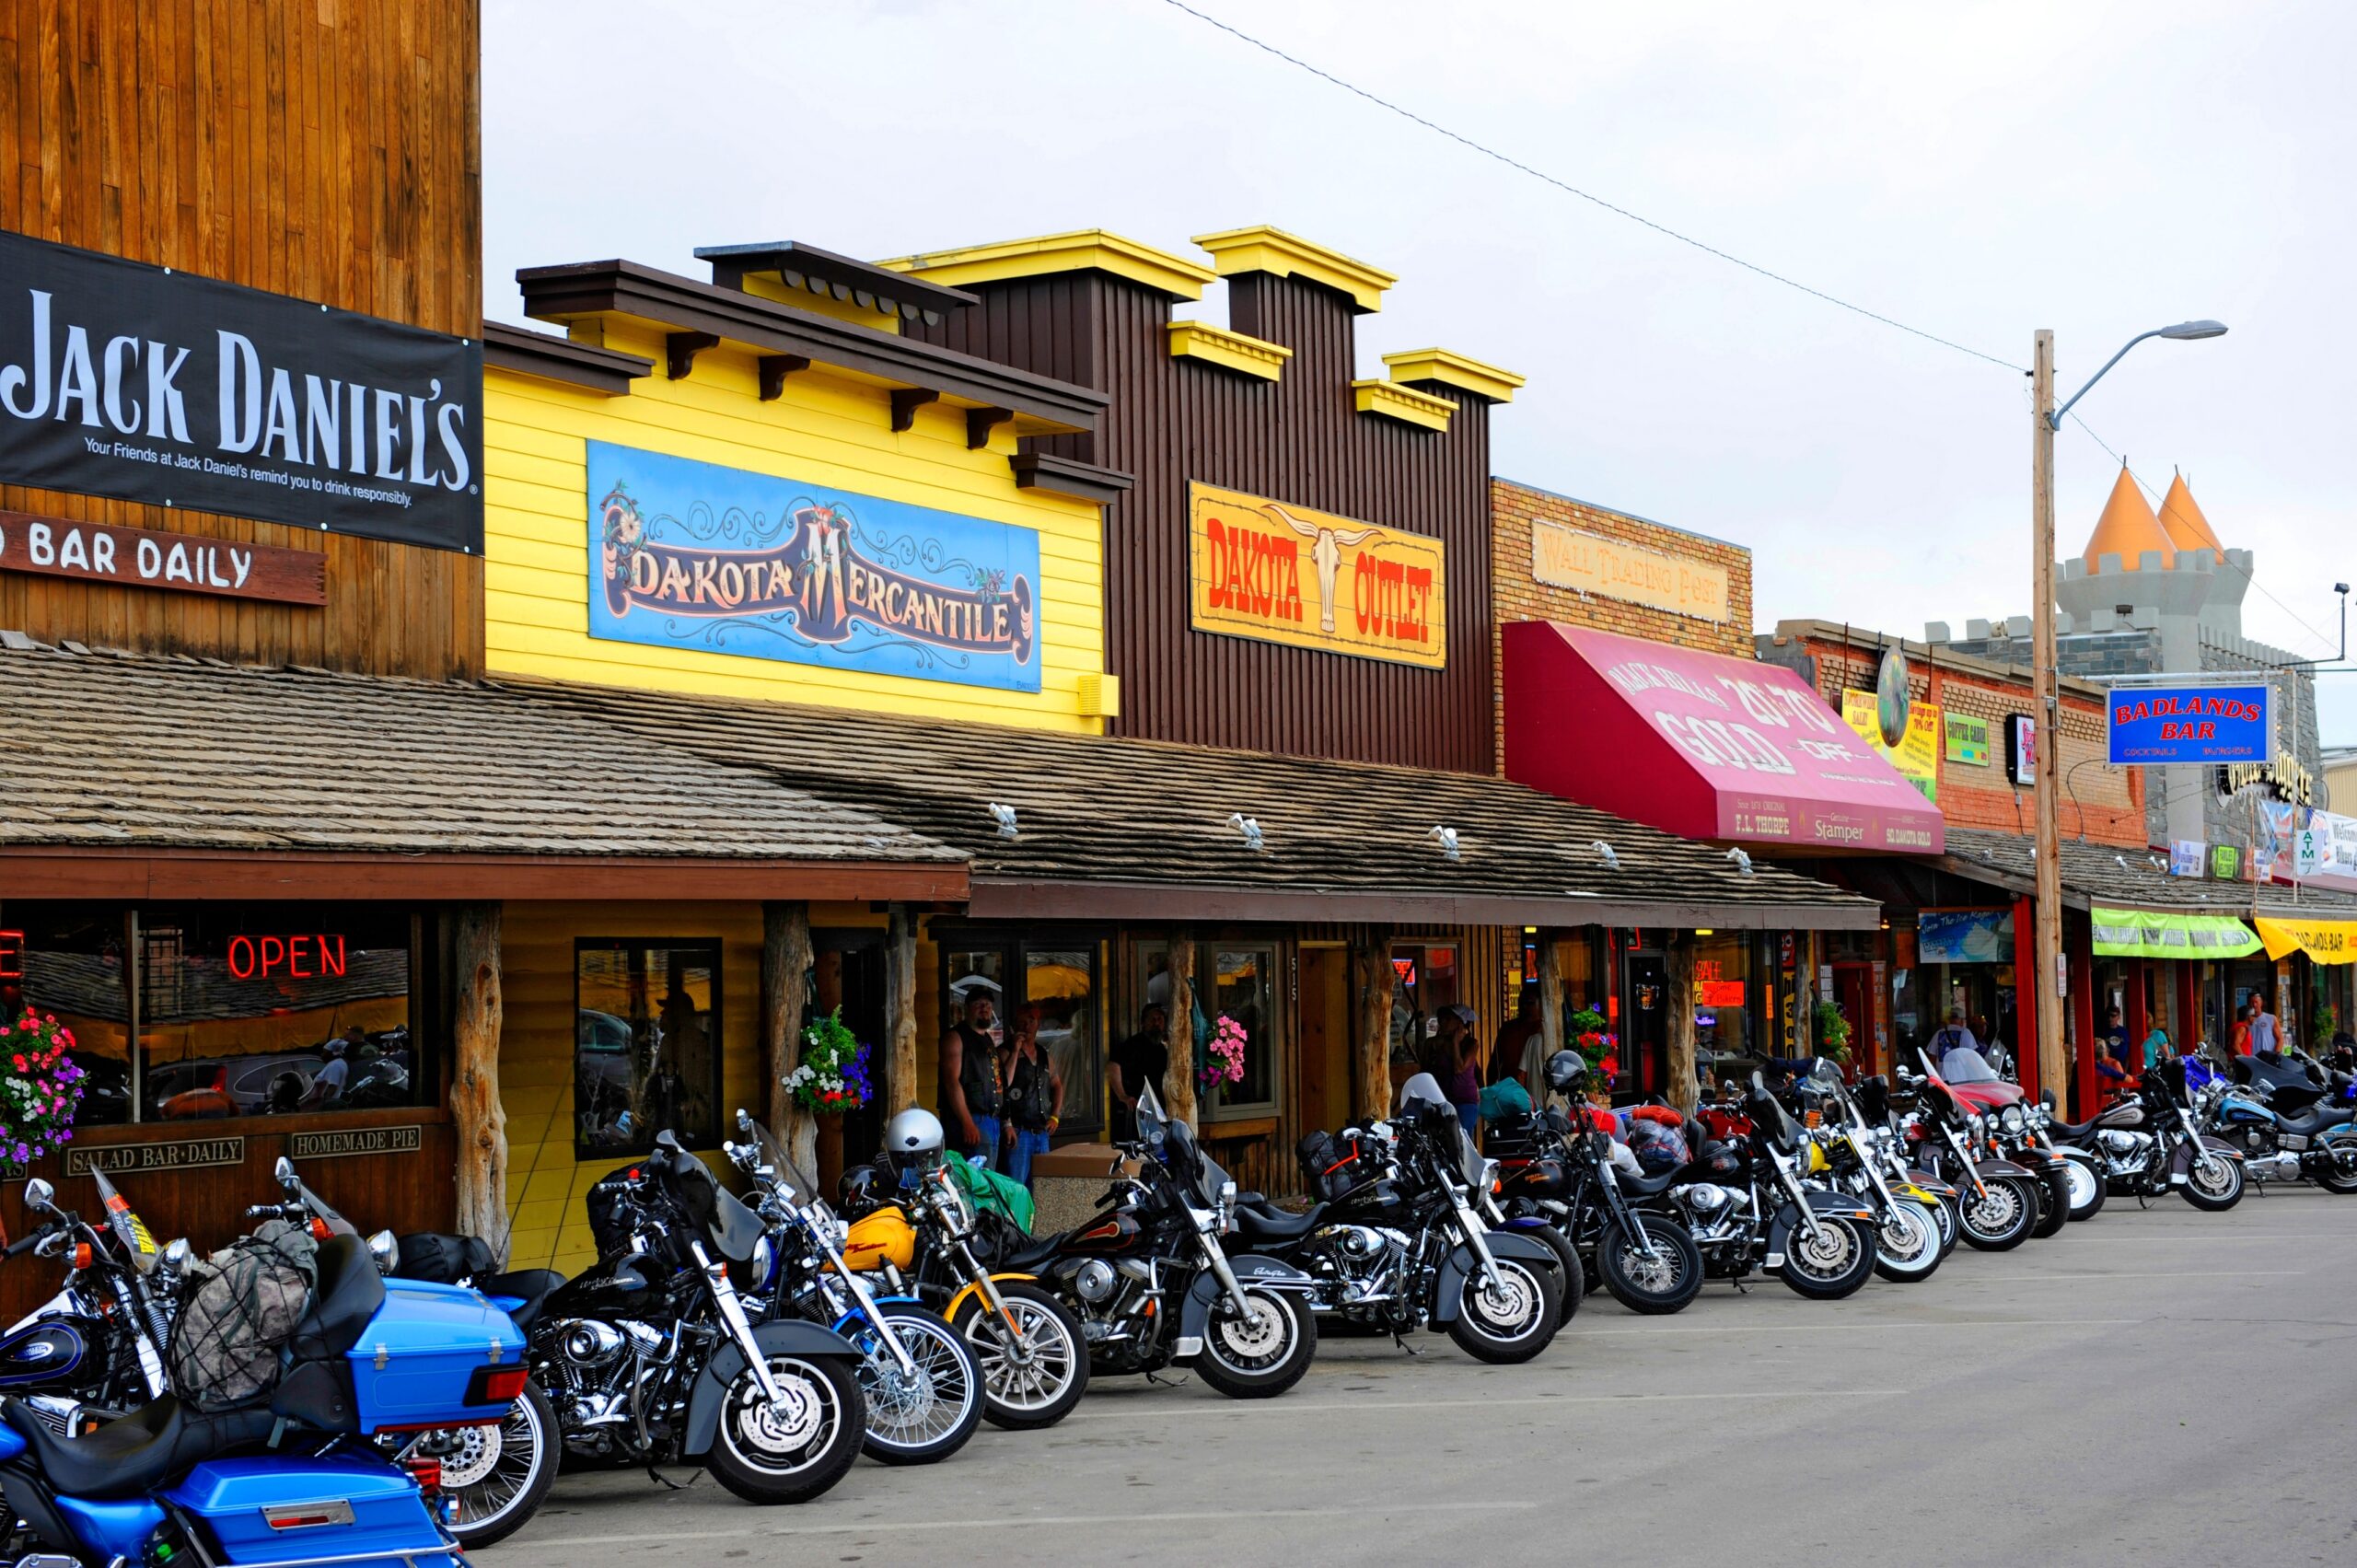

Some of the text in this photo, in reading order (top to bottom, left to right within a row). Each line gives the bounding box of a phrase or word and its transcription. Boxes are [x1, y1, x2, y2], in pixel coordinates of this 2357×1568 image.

[0, 289, 470, 492] JACK DANIEL'S
[85, 437, 412, 508] Your Friends at Jack Daniel's remind you to drink responsibly.
[29, 522, 116, 574] BAR
[137, 538, 251, 589] DAILY
[1542, 531, 1717, 604] WALL TRADING POST
[631, 521, 1012, 643] DAKOTA MERCANTILE
[1206, 517, 1431, 644] DAKOTA OUTLET
[2115, 696, 2261, 726] BADLANDS
[2160, 721, 2215, 740] BAR
[1655, 711, 1796, 775] GOLD
[1756, 815, 1790, 835] THORPE
[1815, 819, 1864, 845] Stamper
[228, 935, 345, 978] OPEN
[2329, 933, 2343, 951] BAR
[73, 1142, 239, 1172] SALAD BAR DAILY
[297, 1130, 416, 1155] HOMEMADE PIE
